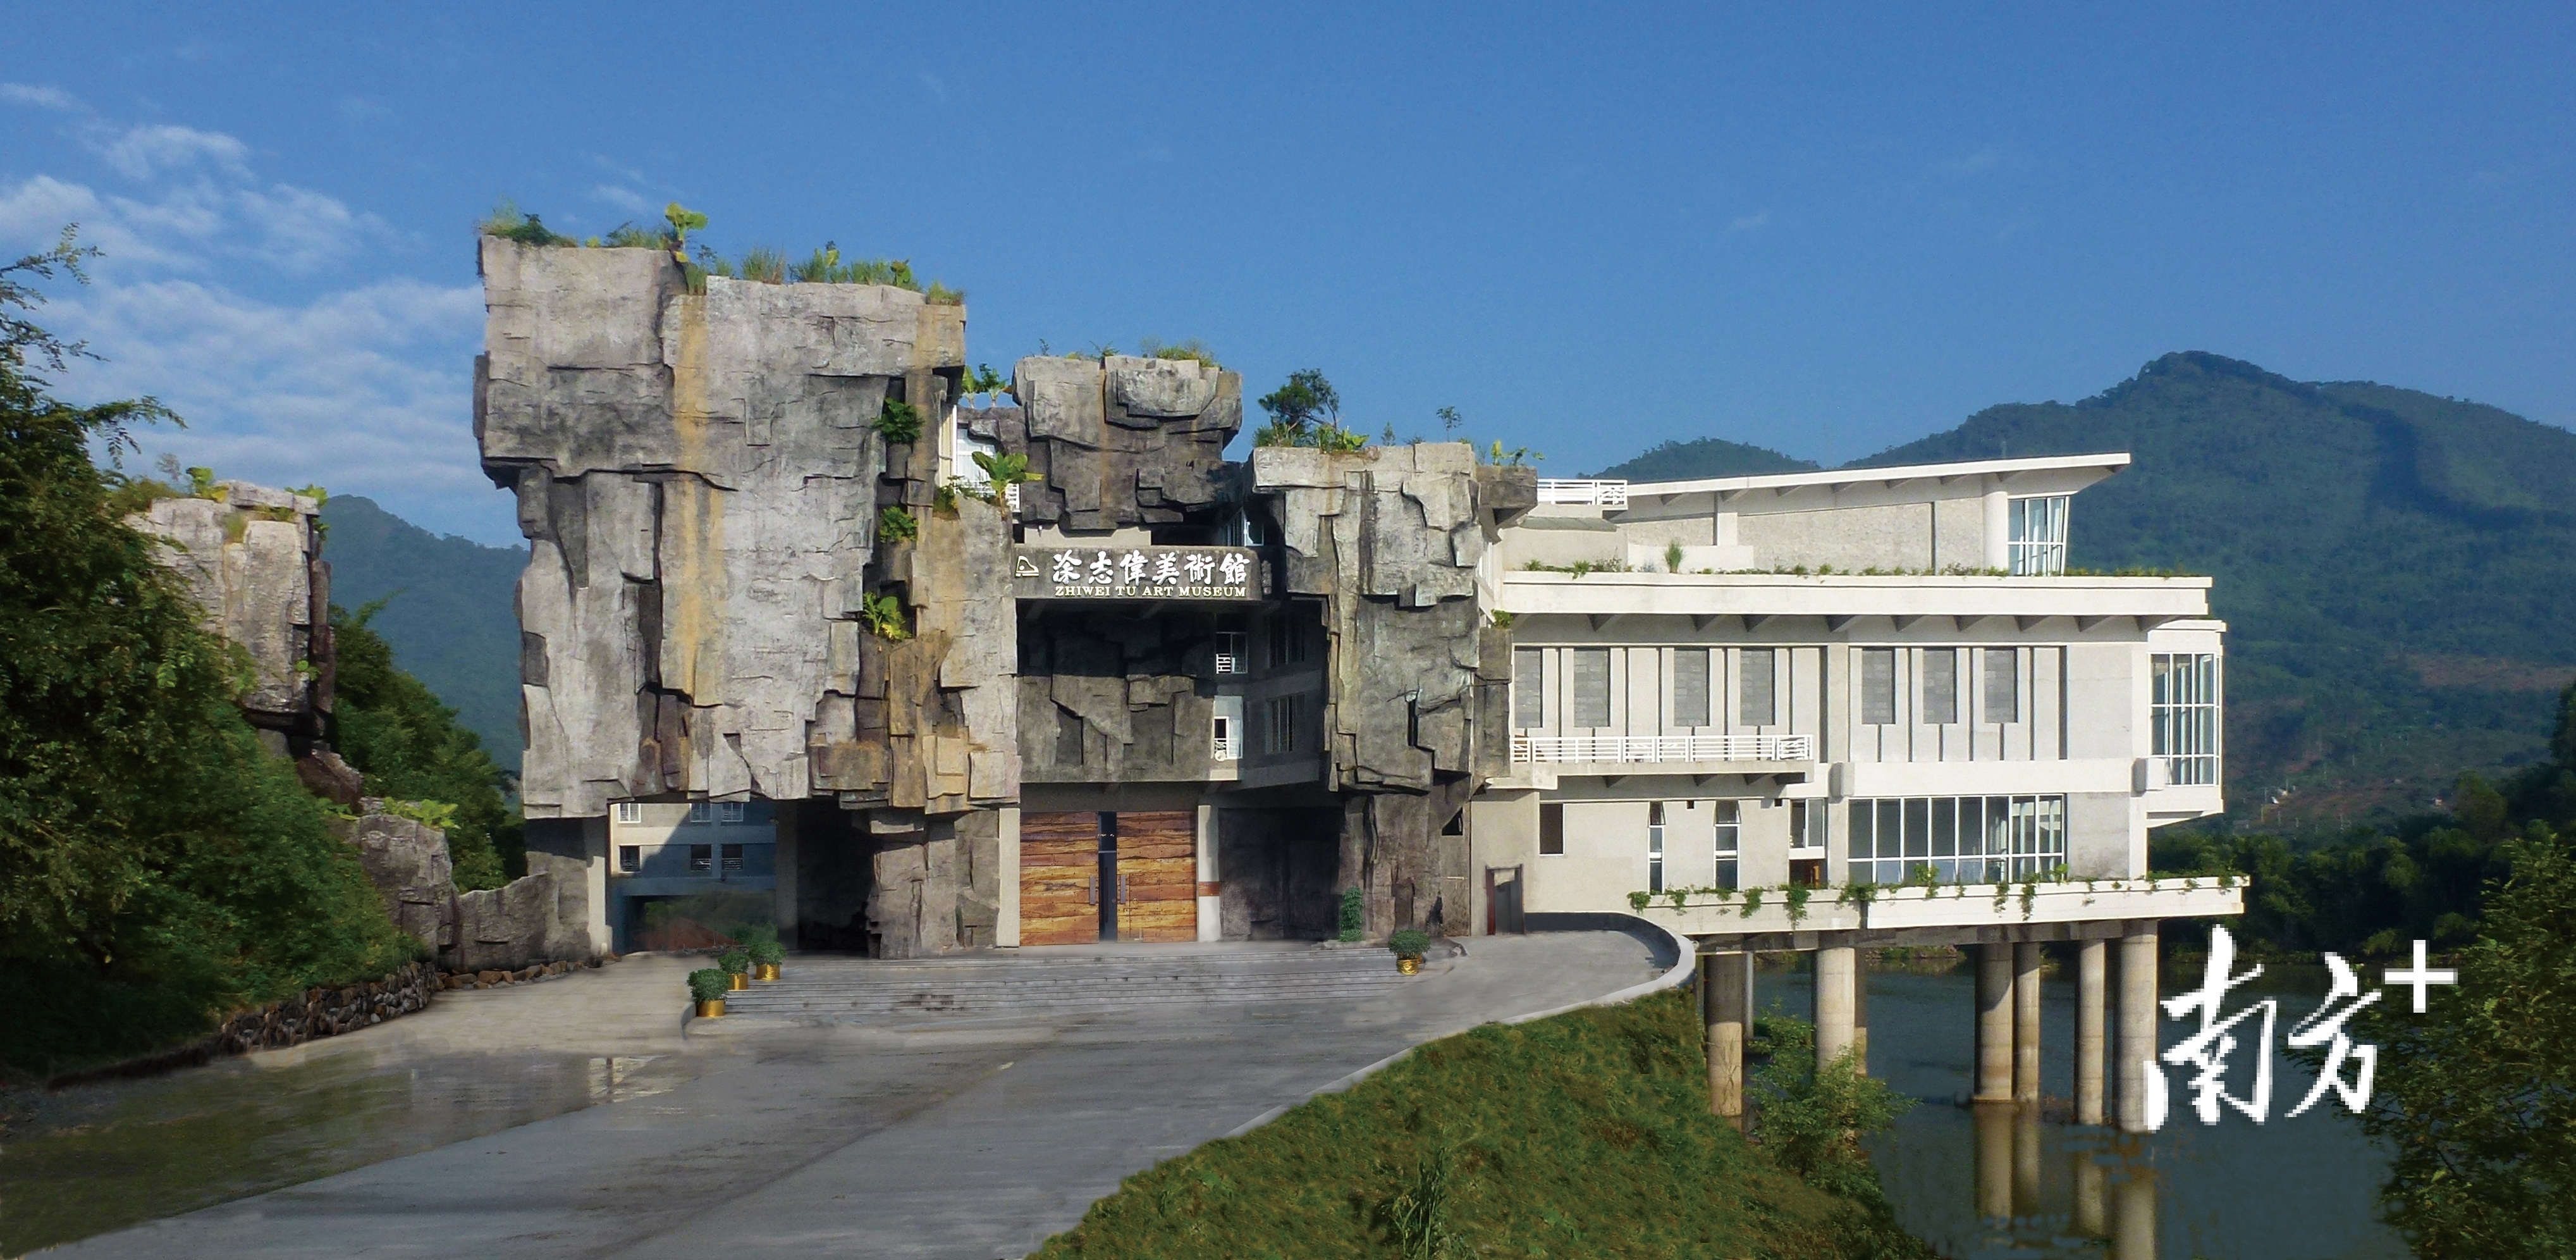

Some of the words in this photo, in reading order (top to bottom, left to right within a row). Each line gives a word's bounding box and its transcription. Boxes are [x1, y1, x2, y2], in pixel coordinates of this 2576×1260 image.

[1052, 549, 1250, 586] 涂志偉美術館
[1055, 586, 1110, 596] ZHIWEI
[1115, 586, 1137, 596] TU
[1142, 586, 1174, 596] ART
[1179, 586, 1247, 597] MUSEUM
